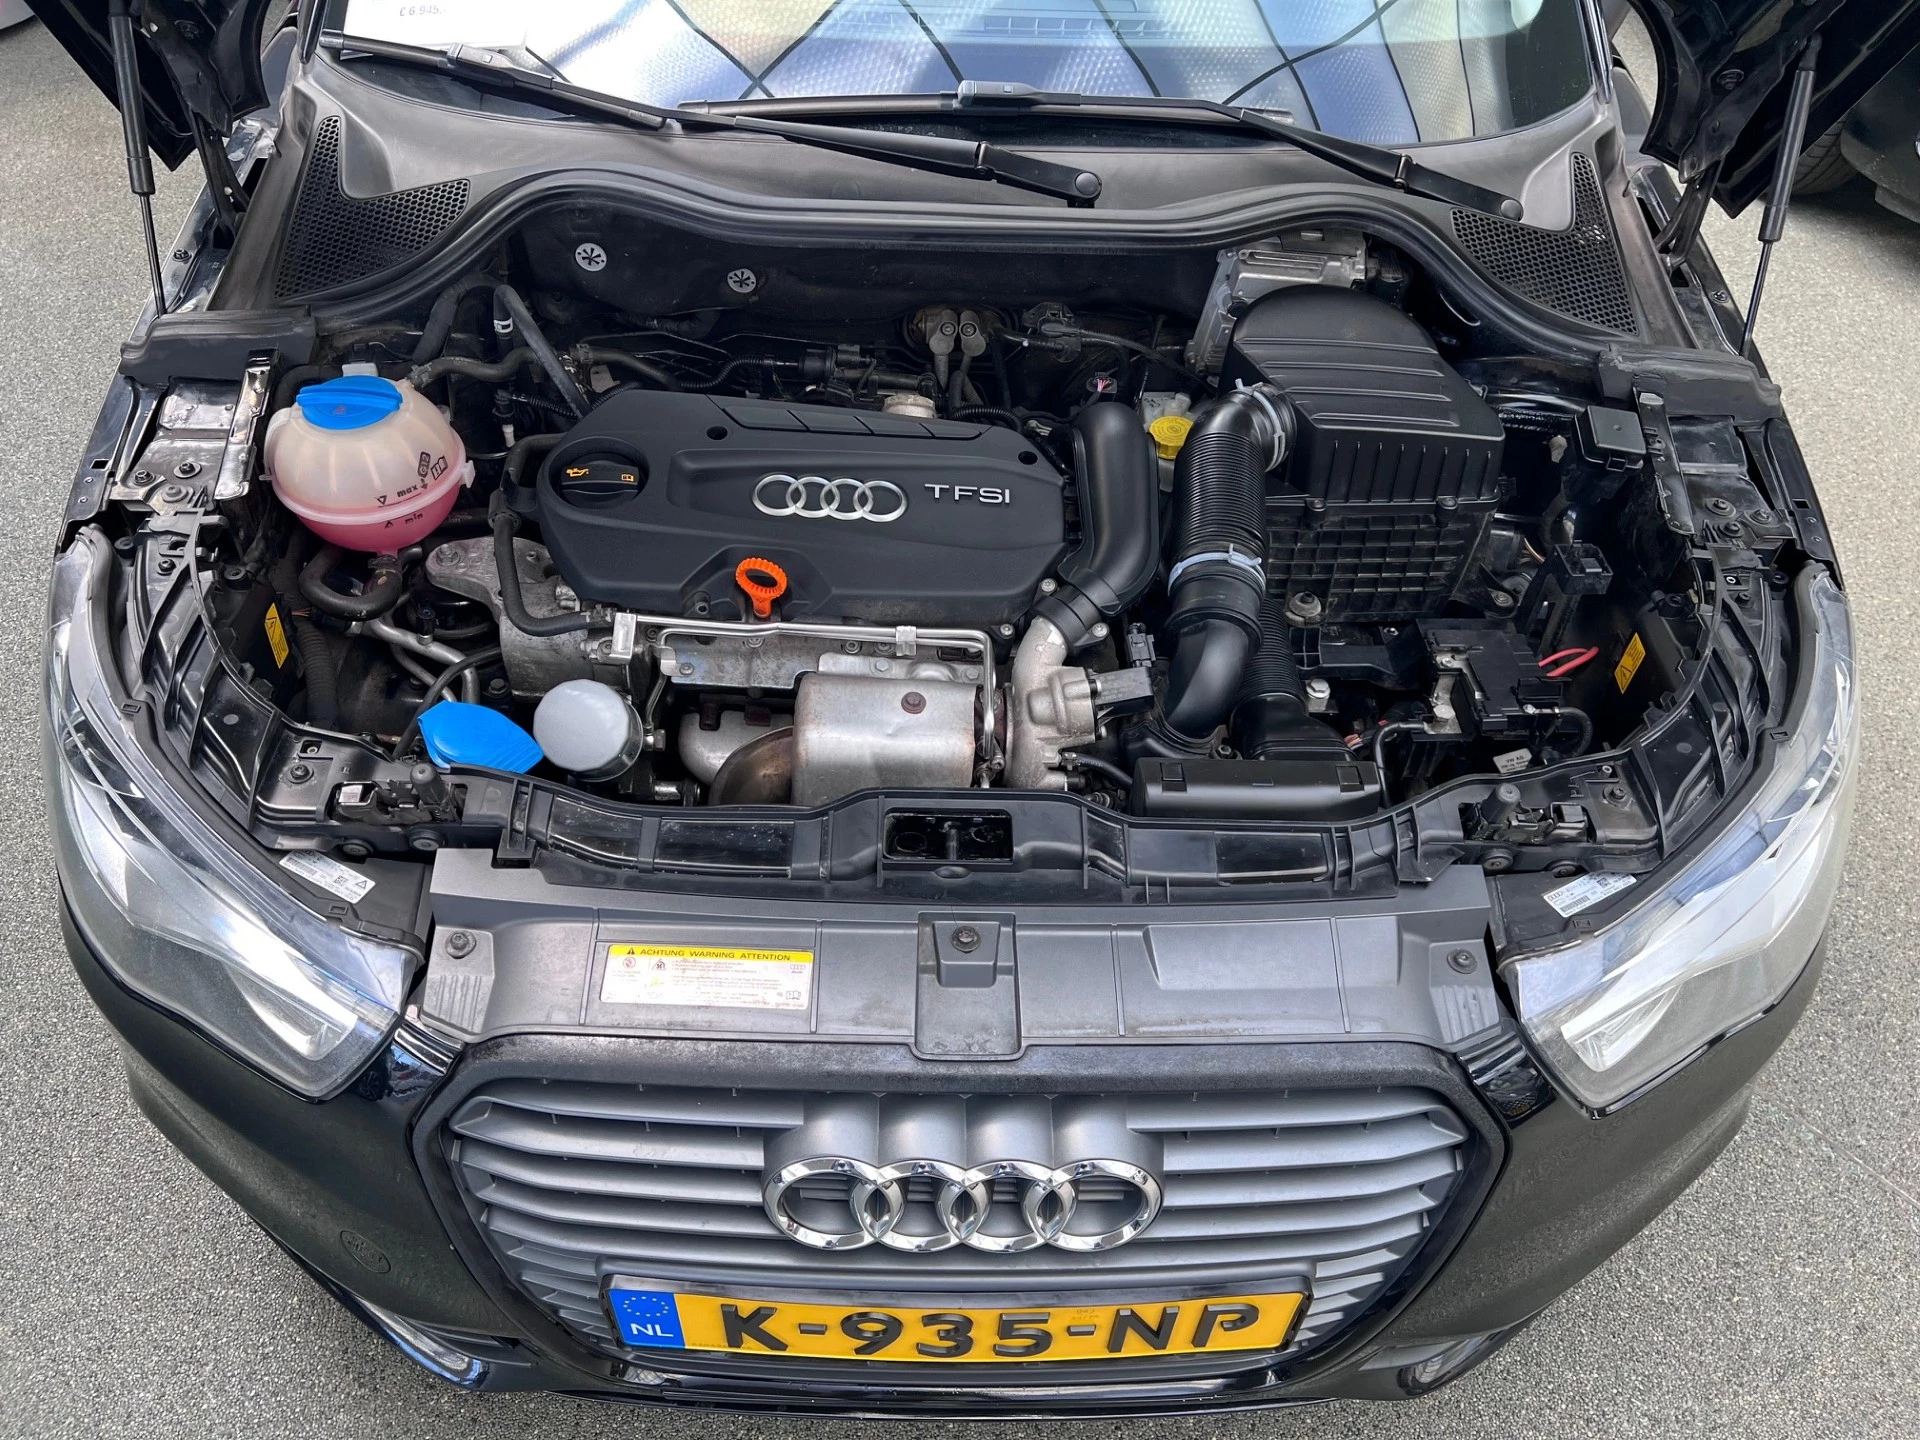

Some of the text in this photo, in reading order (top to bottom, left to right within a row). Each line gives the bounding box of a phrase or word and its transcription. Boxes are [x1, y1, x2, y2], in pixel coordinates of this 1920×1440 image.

[397, 485, 418, 497] max
[924, 483, 1010, 504] TFSI
[404, 513, 423, 524] min
[639, 949, 685, 957] ACHTUNG
[739, 952, 791, 961] ATTENTION
[630, 1322, 674, 1338] NL
[720, 1303, 1260, 1358] K-935-NP
